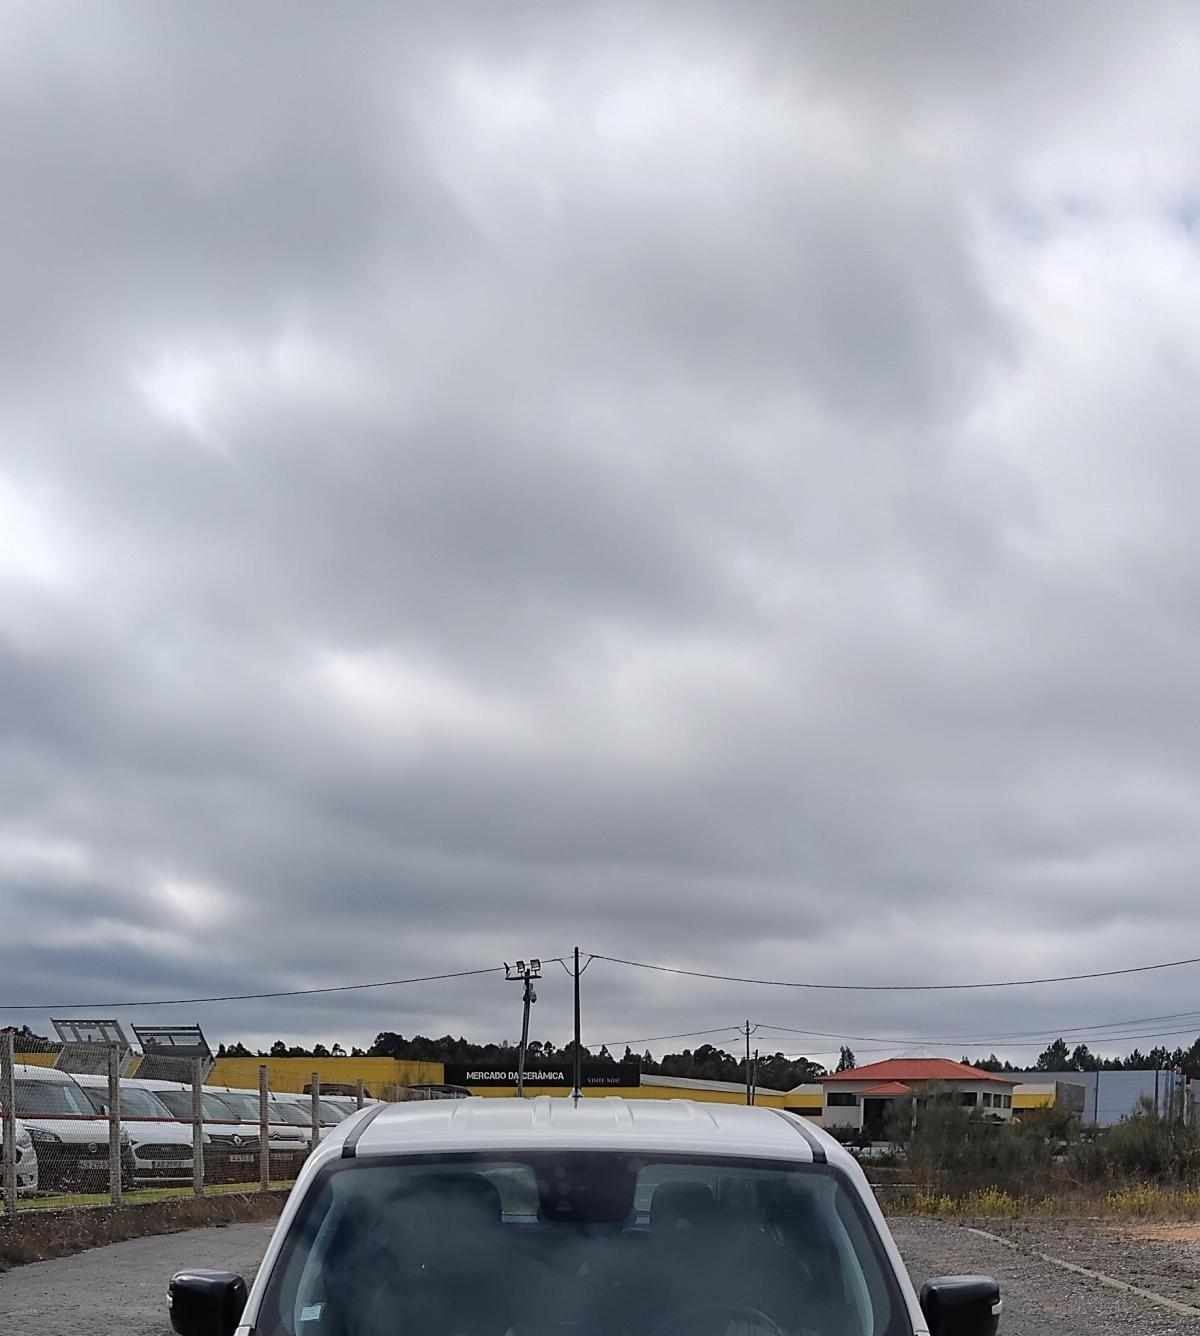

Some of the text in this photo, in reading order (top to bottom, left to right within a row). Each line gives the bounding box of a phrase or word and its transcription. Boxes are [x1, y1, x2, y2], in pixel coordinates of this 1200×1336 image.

[466, 1069, 565, 1080] MERCADO DA CERÂMICA
